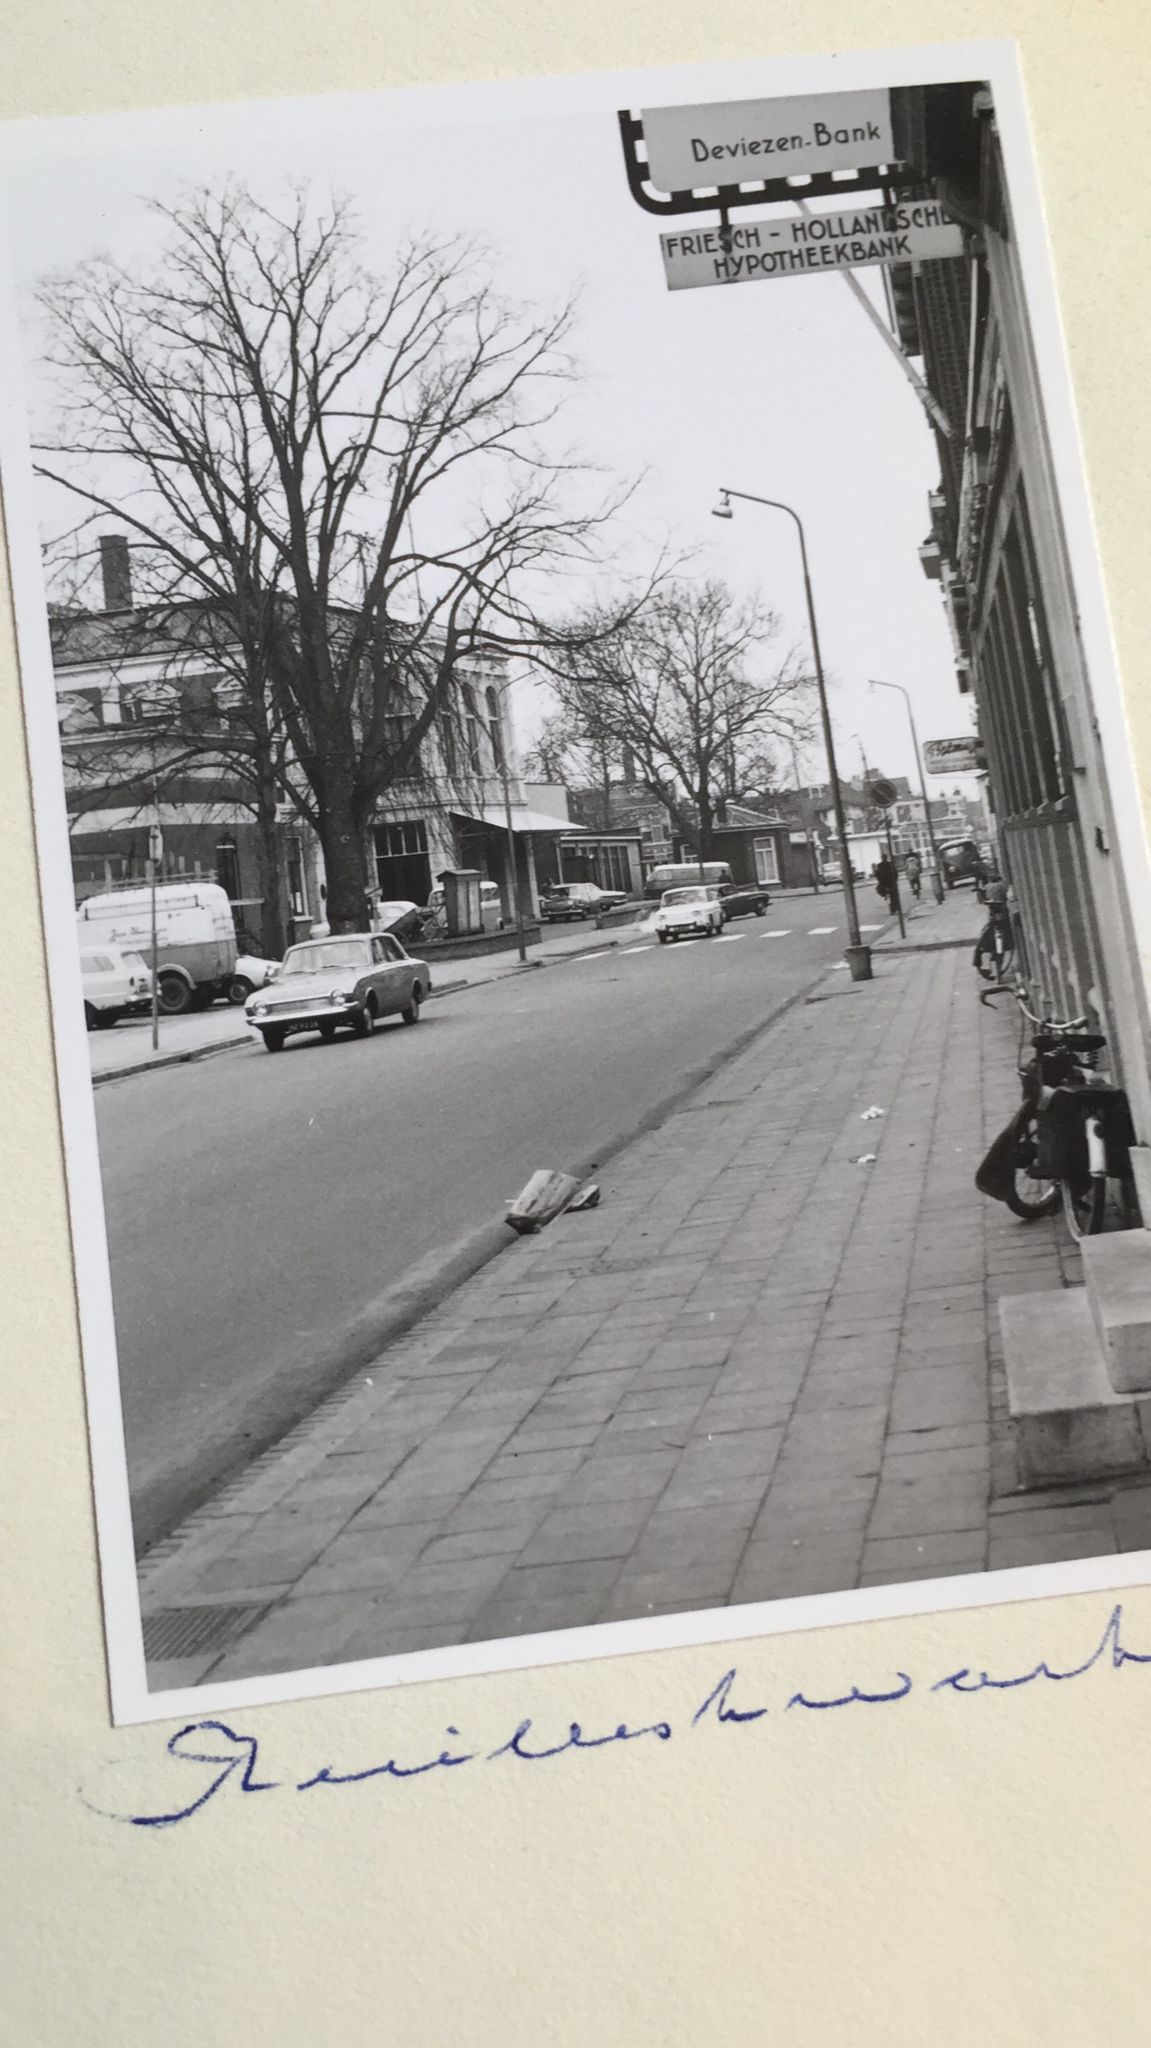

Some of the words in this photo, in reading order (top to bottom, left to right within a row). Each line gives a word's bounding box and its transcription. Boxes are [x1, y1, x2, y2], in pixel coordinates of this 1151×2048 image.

[691, 121, 881, 163] Deviezen-Bank
[666, 227, 761, 259] FRIESCH
[713, 235, 912, 279] HYPOTHEEKBANK
